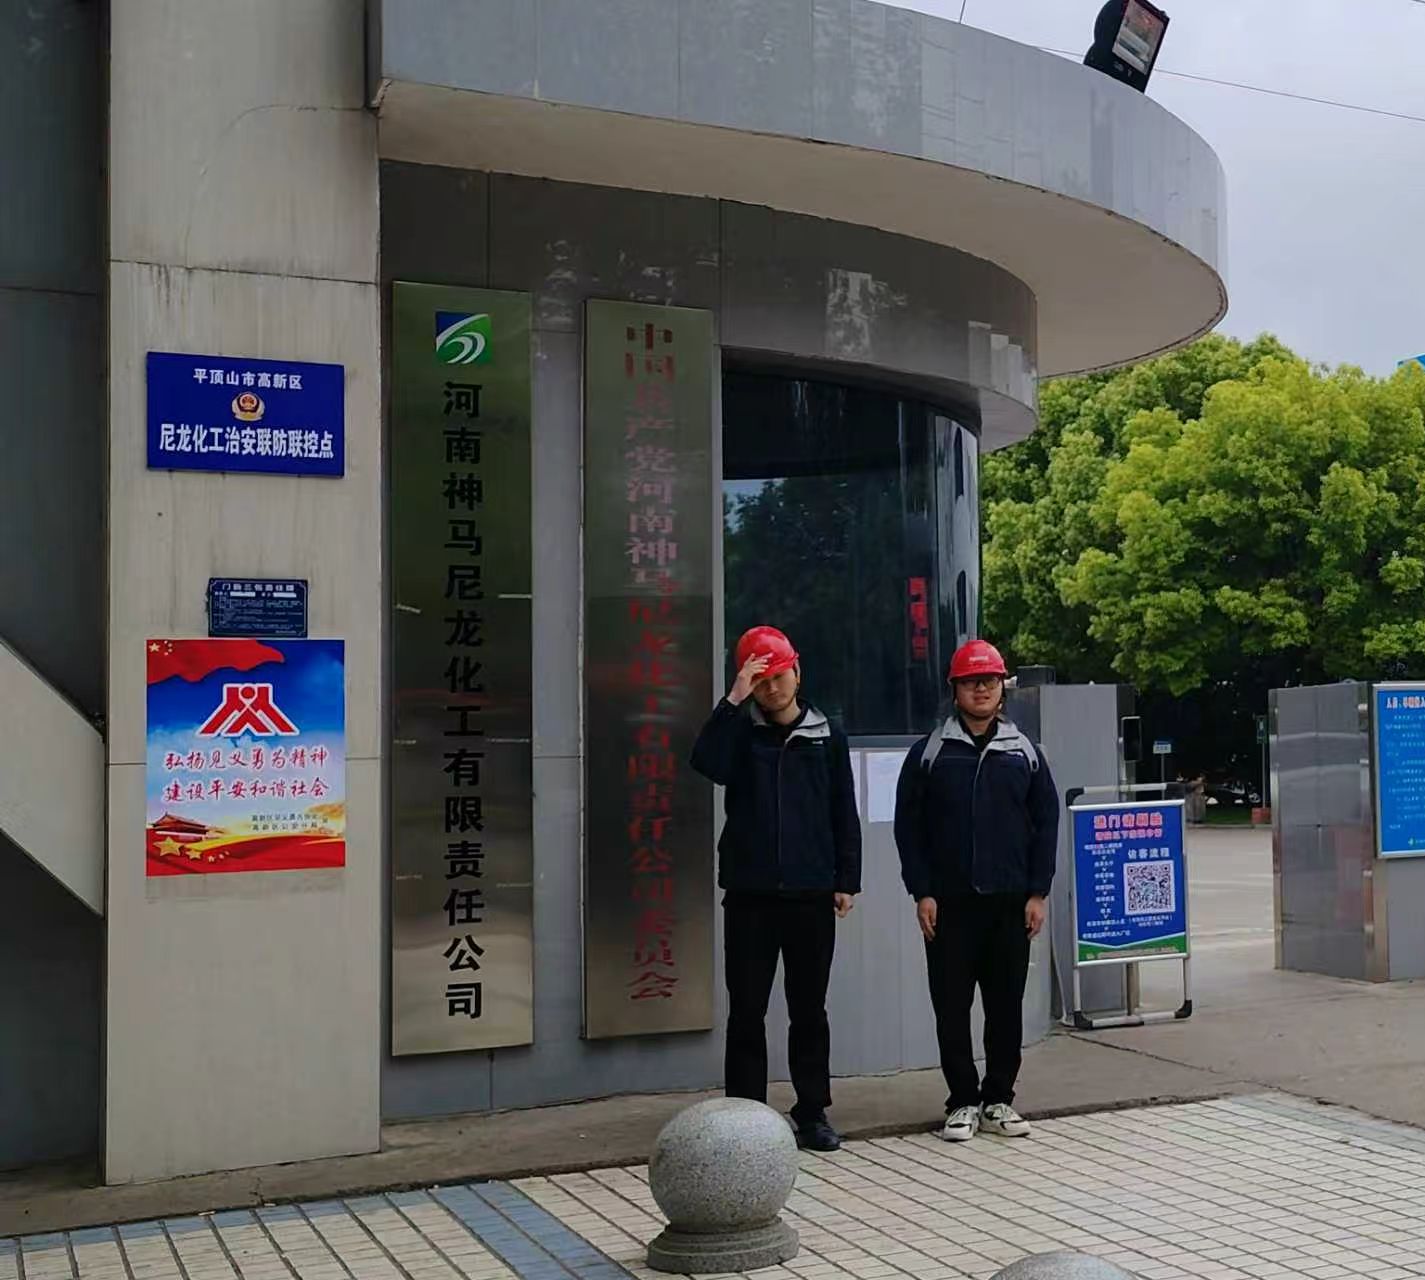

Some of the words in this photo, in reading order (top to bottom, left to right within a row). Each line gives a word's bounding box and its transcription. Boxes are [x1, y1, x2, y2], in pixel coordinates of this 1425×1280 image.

[193, 367, 303, 390] 平顶山市高新区
[159, 423, 335, 459] 尼龙化工治安联防联控点
[443, 381, 485, 1019] 河南神马尼龙化工有限责任公司
[164, 746, 329, 770] 弘扬见义勇为精神
[163, 776, 330, 802] 建设平安和谐社会
